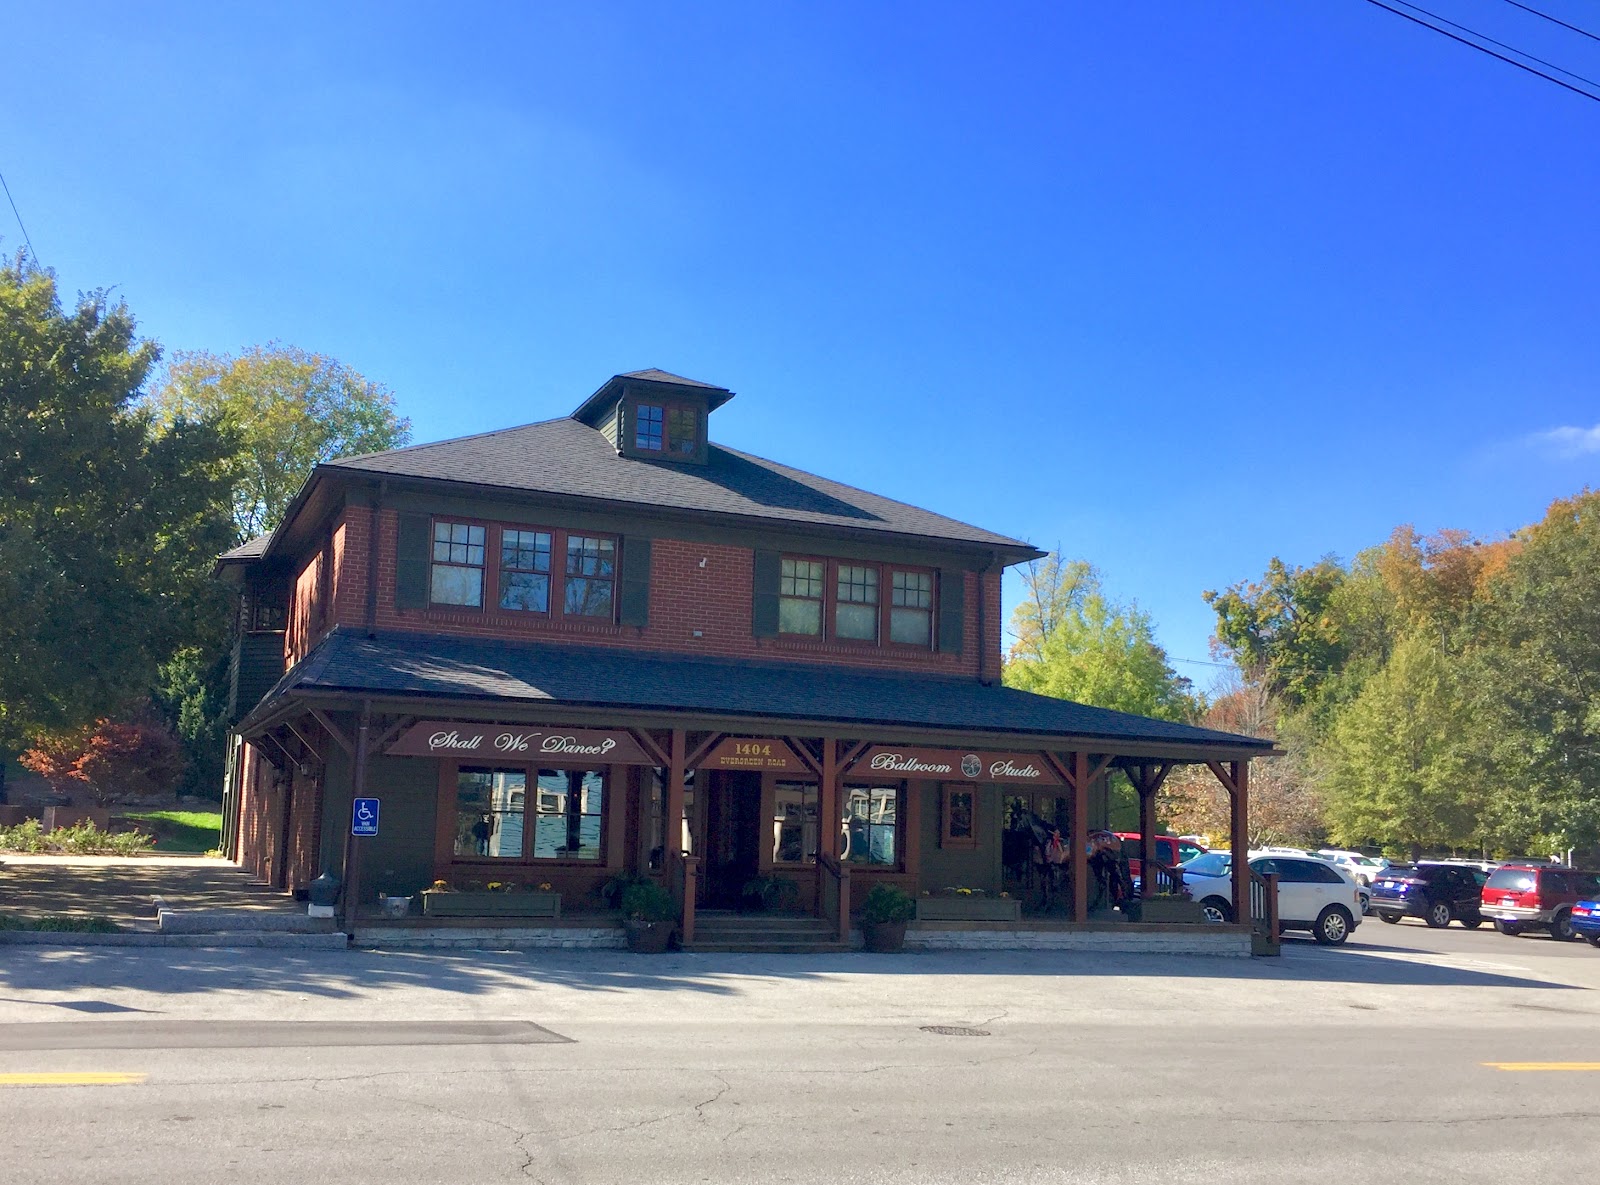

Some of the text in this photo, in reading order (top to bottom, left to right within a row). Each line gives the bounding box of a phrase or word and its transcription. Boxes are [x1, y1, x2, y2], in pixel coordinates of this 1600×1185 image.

[429, 731, 616, 755] Shall We Dance?
[735, 744, 771, 756] 1404
[720, 757, 786, 767] EVERGREEN ROAD
[871, 753, 1041, 778] Ballroom Studio
